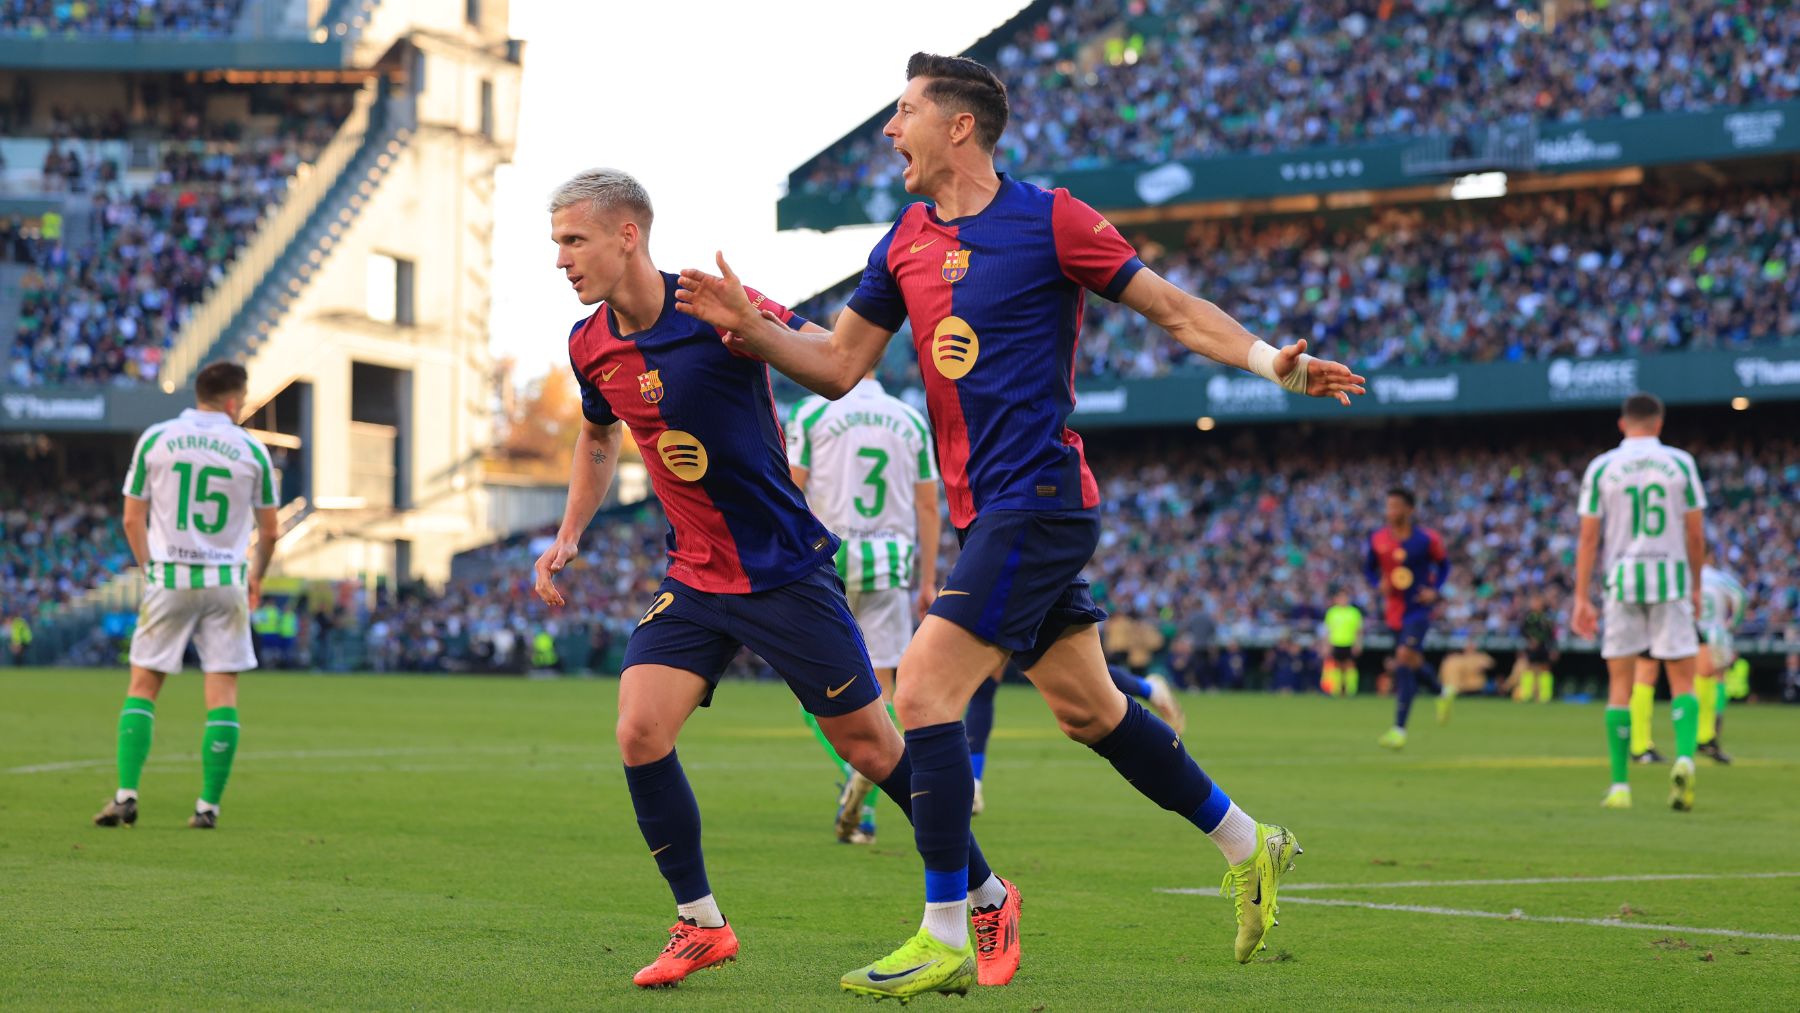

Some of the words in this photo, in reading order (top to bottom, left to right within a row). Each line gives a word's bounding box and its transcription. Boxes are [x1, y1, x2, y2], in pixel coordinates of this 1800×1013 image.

[166, 435, 241, 461] PERRAUD
[828, 411, 900, 437] LLORENTE
[171, 462, 232, 535] 15
[853, 447, 889, 519] 3
[1624, 483, 1666, 539] 16
